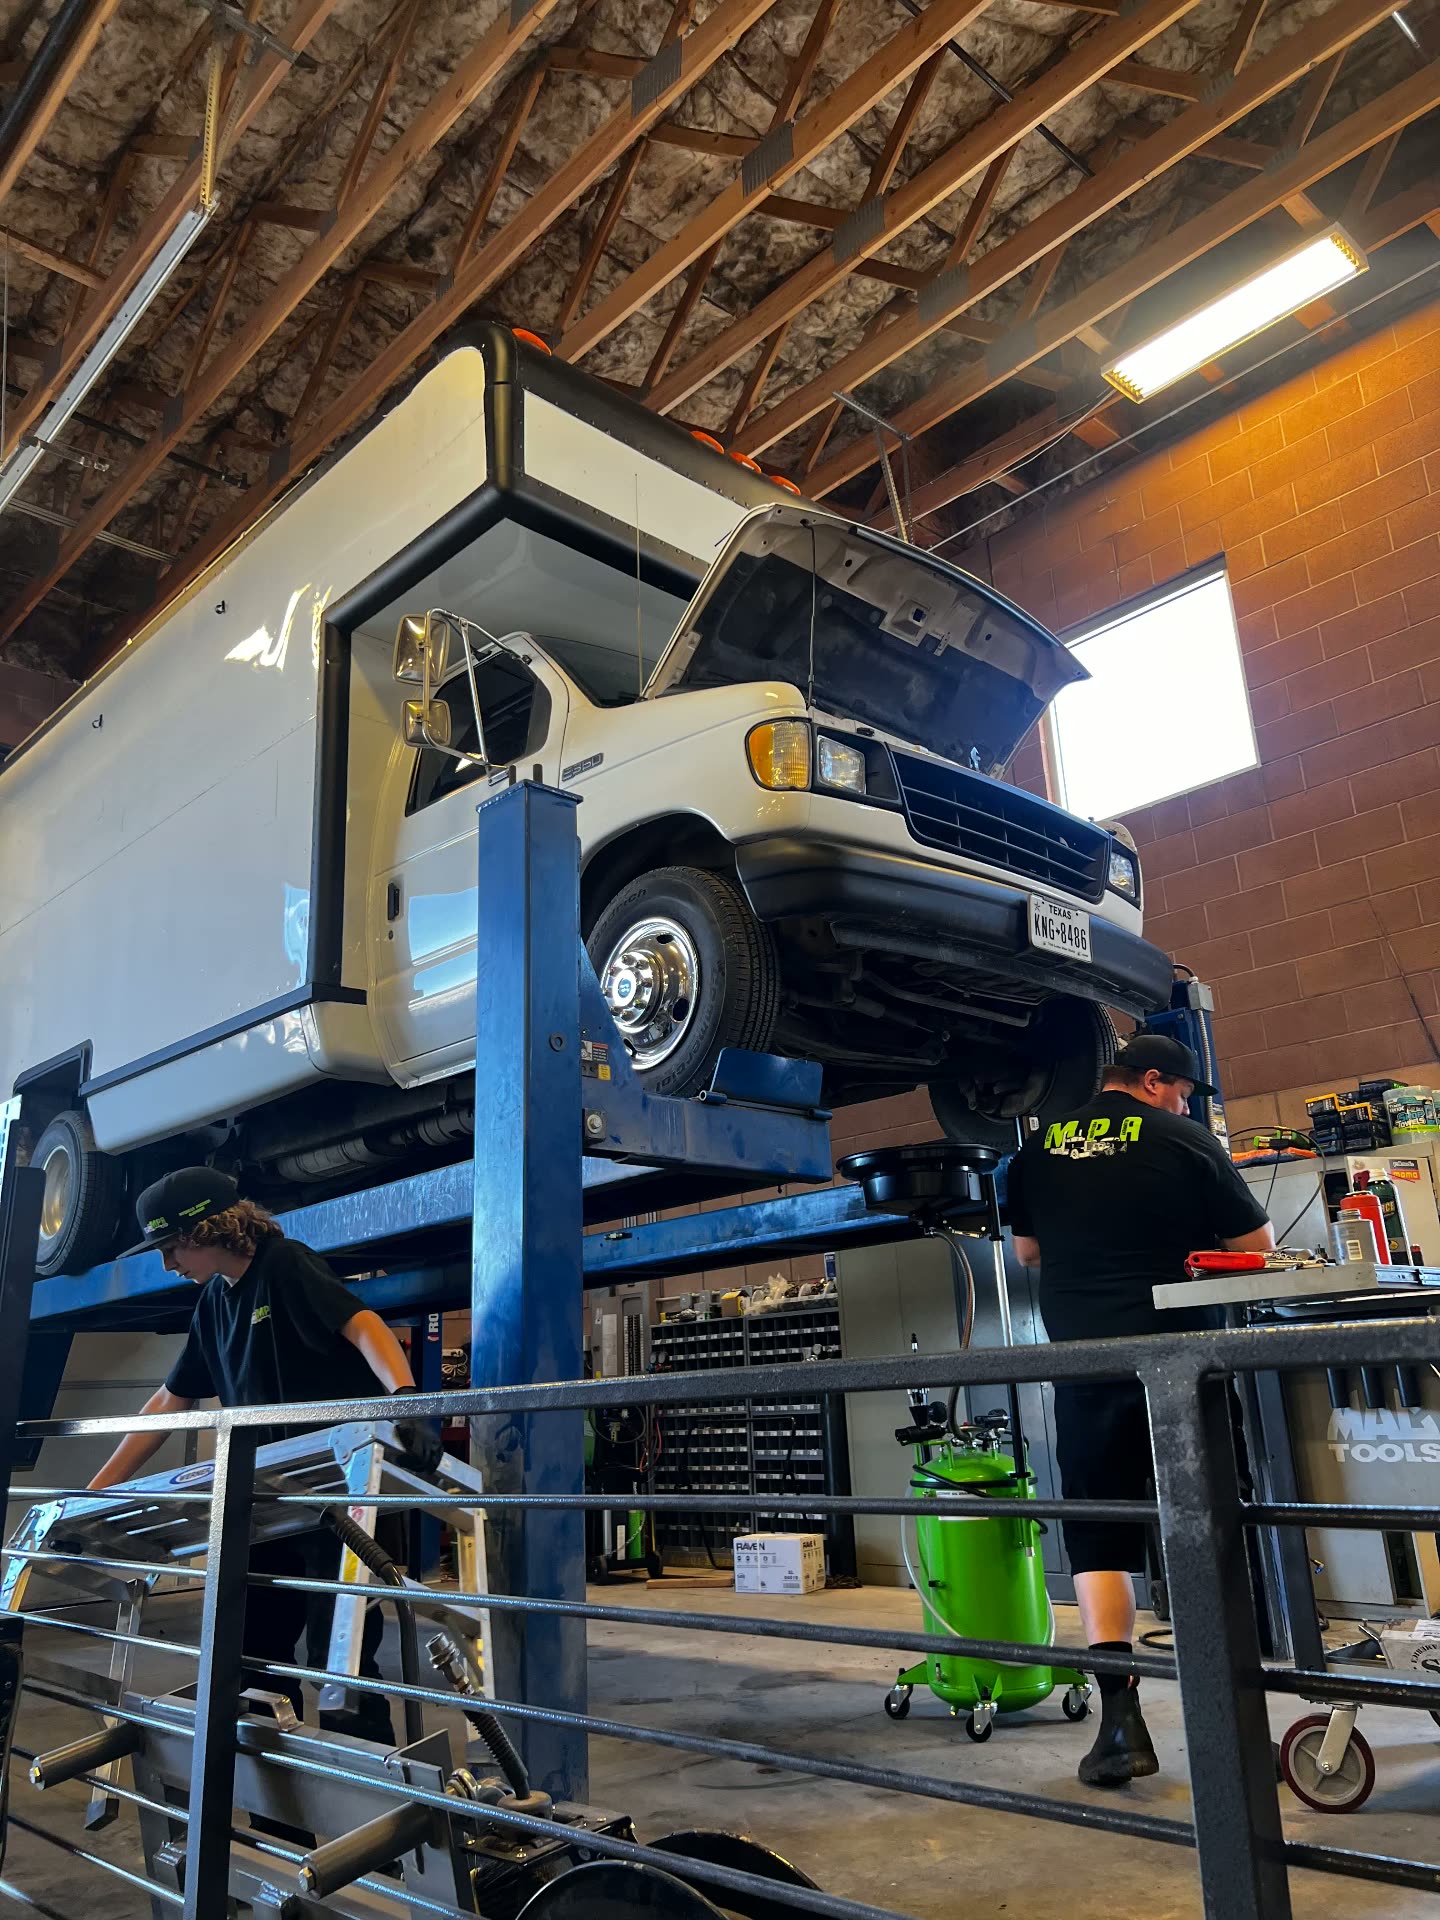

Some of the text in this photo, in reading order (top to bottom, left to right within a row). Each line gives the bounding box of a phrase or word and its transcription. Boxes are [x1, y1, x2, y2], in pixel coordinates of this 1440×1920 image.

[1048, 904, 1072, 920] TEXAS
[1327, 1442, 1440, 1463] TOOLS
[736, 1541, 766, 1551] RAVEN
